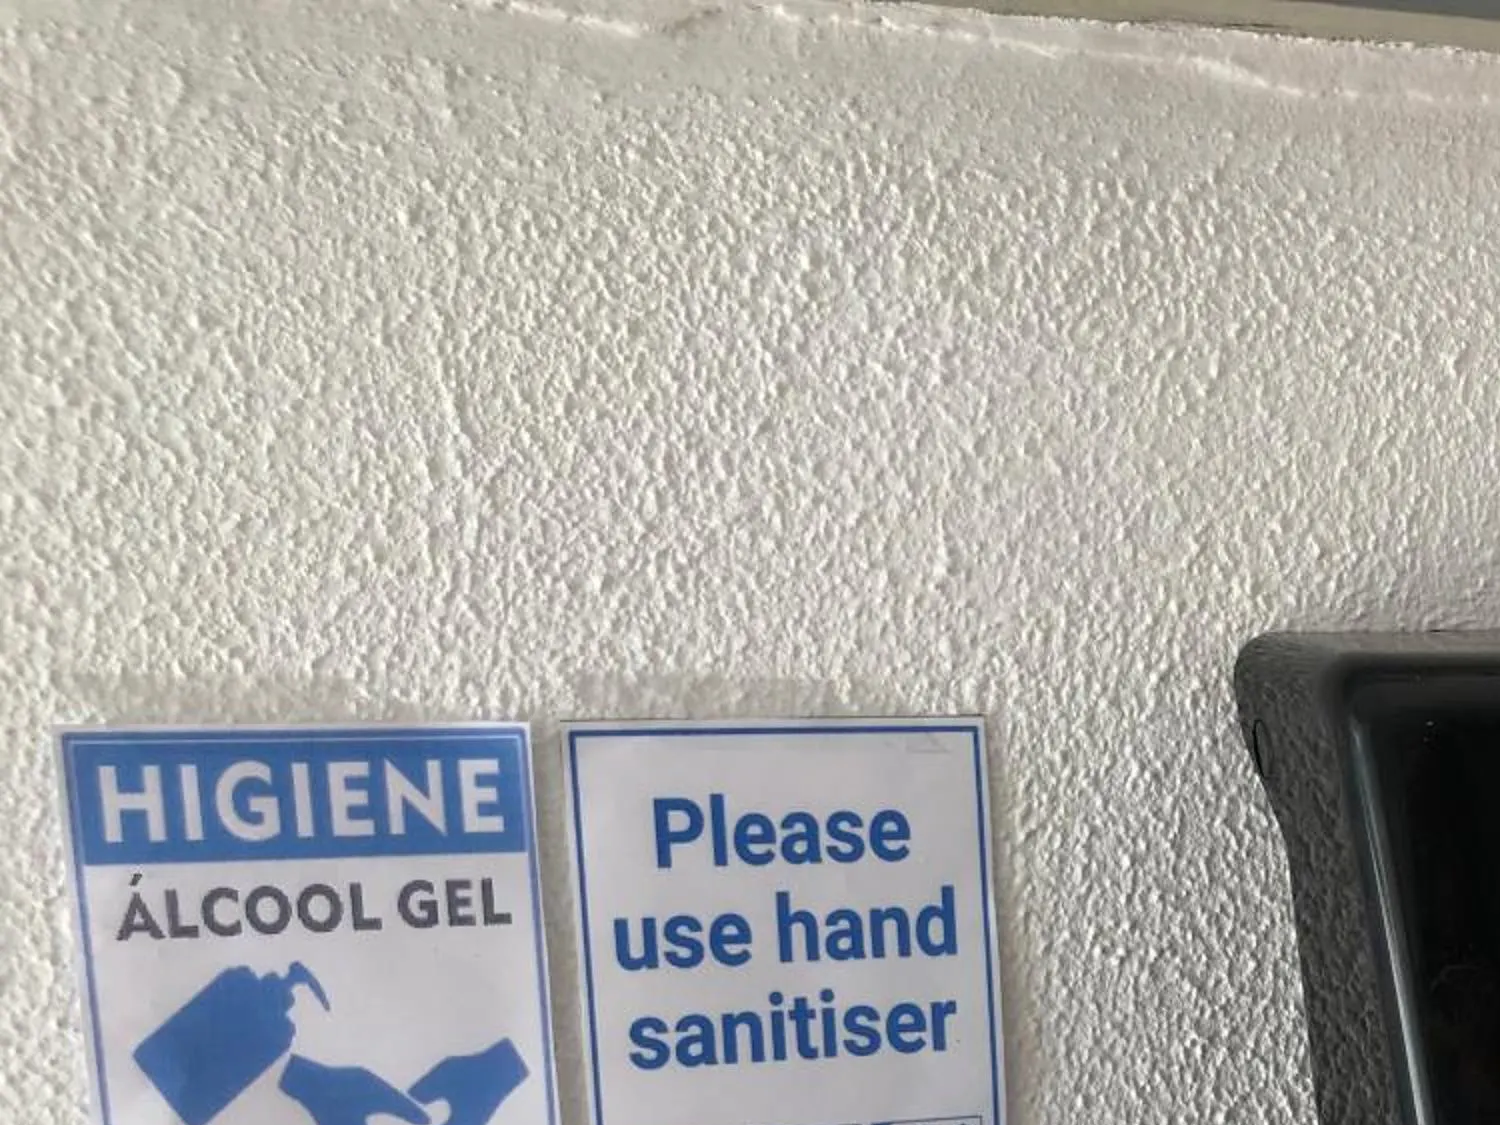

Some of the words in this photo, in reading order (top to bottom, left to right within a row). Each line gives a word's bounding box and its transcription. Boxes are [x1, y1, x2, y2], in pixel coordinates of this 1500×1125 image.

[98, 757, 505, 844] HIGIENE
[652, 792, 912, 870] Please
[115, 872, 383, 942] ÁLCOOL
[397, 877, 513, 929] GEL
[613, 912, 754, 972] use
[774, 884, 959, 964] hand
[628, 987, 958, 1071] sanitiser
